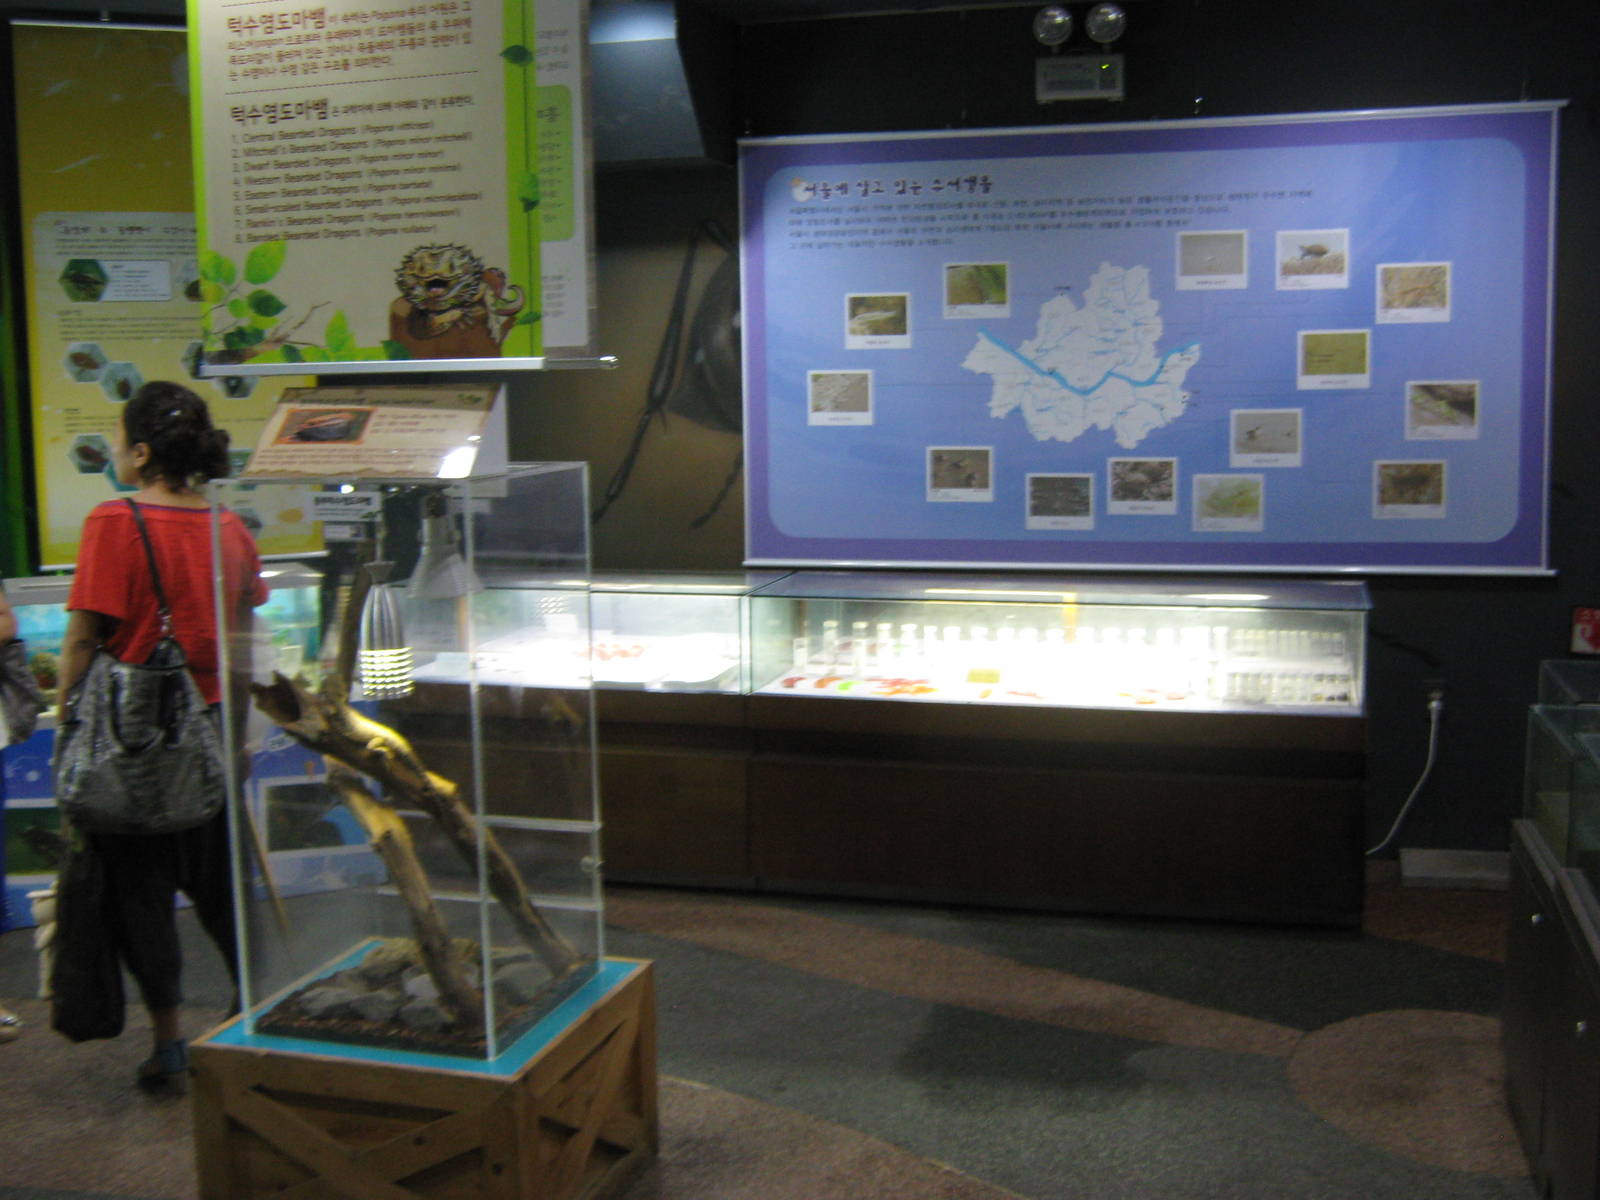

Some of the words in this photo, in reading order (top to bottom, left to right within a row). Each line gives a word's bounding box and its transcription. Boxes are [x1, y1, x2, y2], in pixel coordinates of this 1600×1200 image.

[228, 8, 326, 36] 턱수염도마뱀
[230, 98, 328, 127] 턱수염도마뱀
[804, 180, 849, 200] 서울에
[856, 179, 885, 197] 살고
[894, 179, 922, 196] 있는
